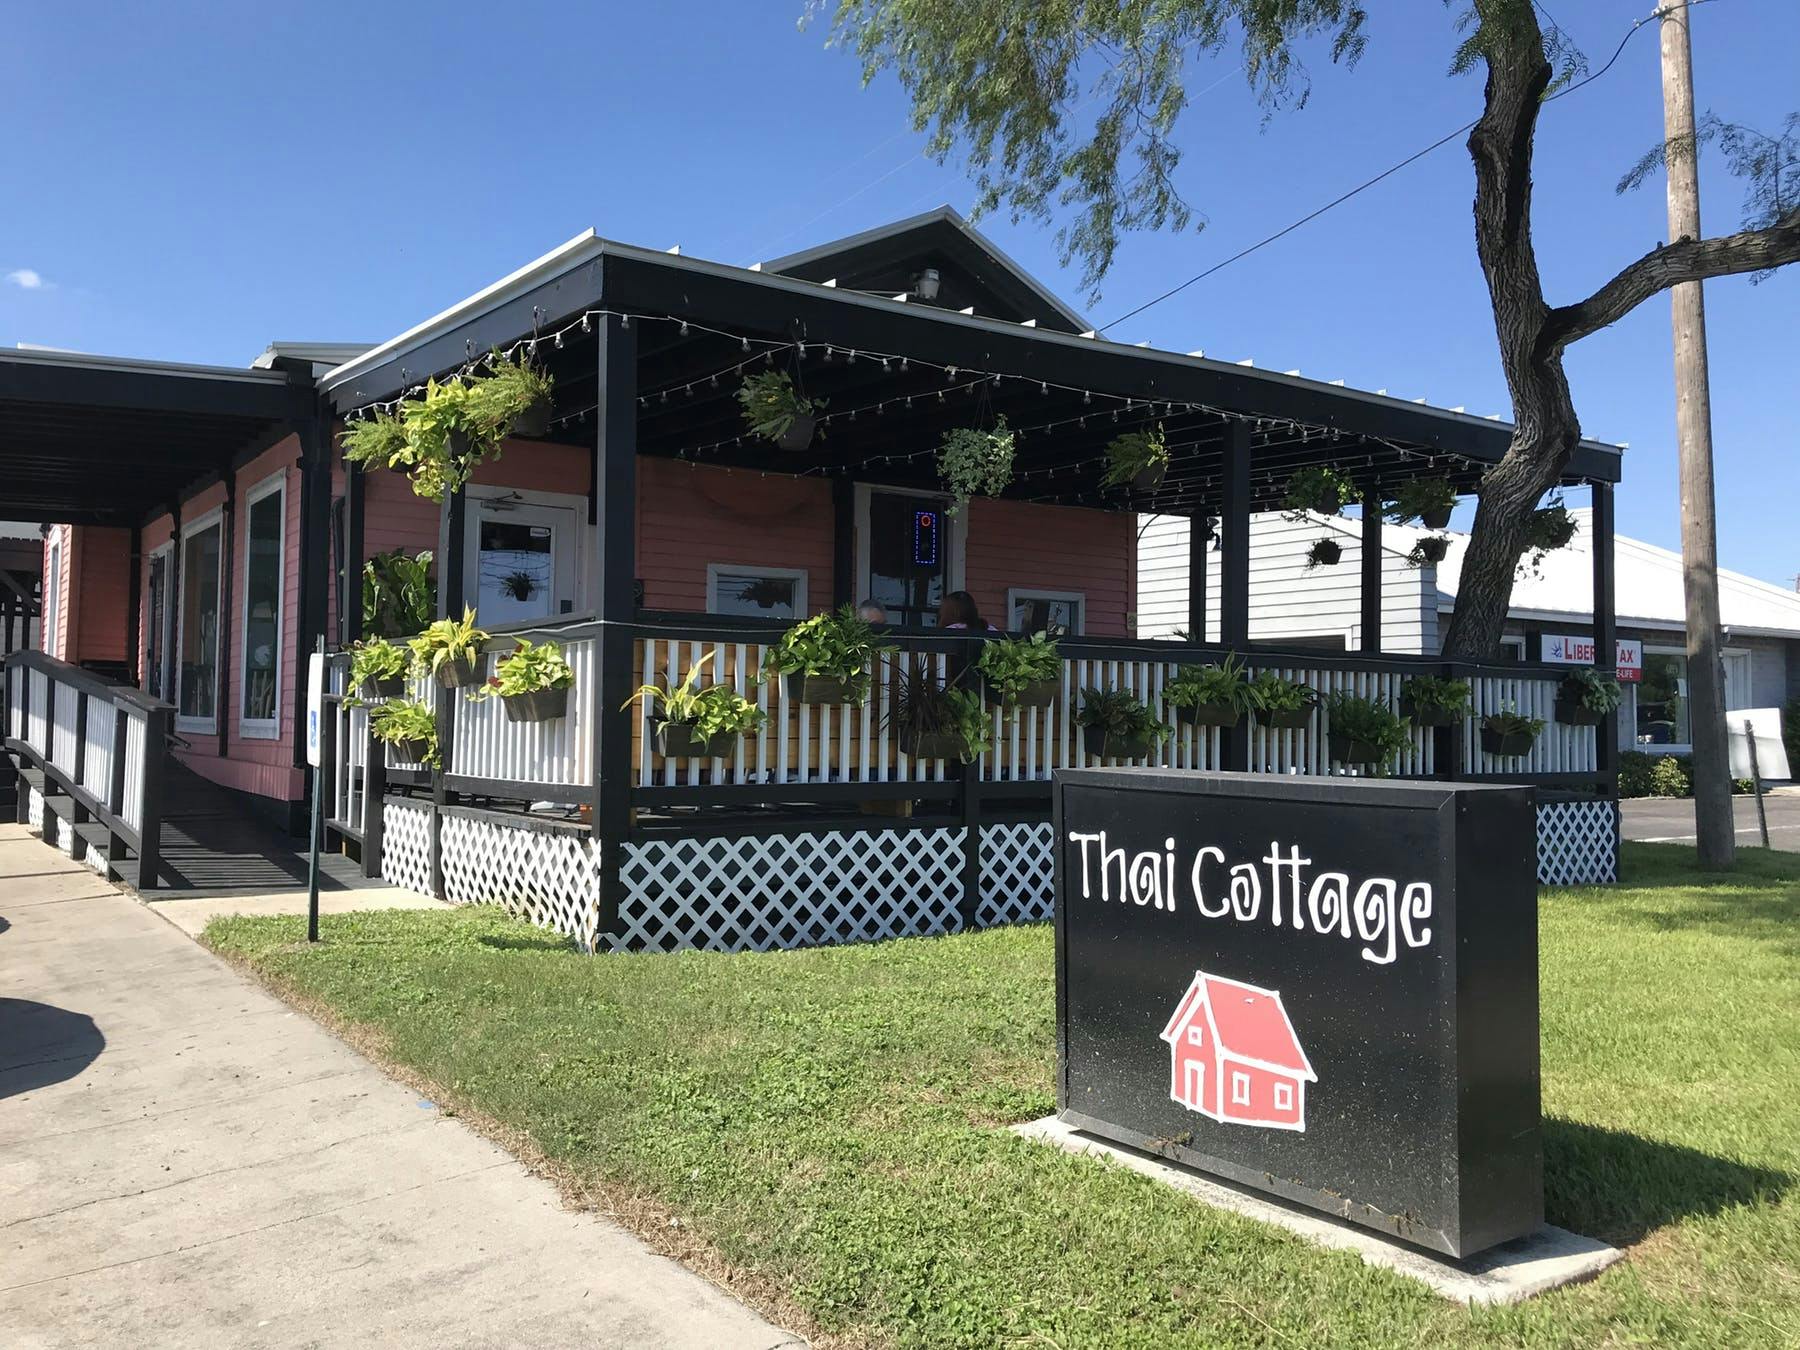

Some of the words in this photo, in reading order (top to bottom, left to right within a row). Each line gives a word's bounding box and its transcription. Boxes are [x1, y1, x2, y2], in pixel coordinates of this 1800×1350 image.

[1564, 638, 1595, 661] LIBER
[1069, 831, 1175, 911] Thai
[1191, 841, 1432, 964] Cottage
